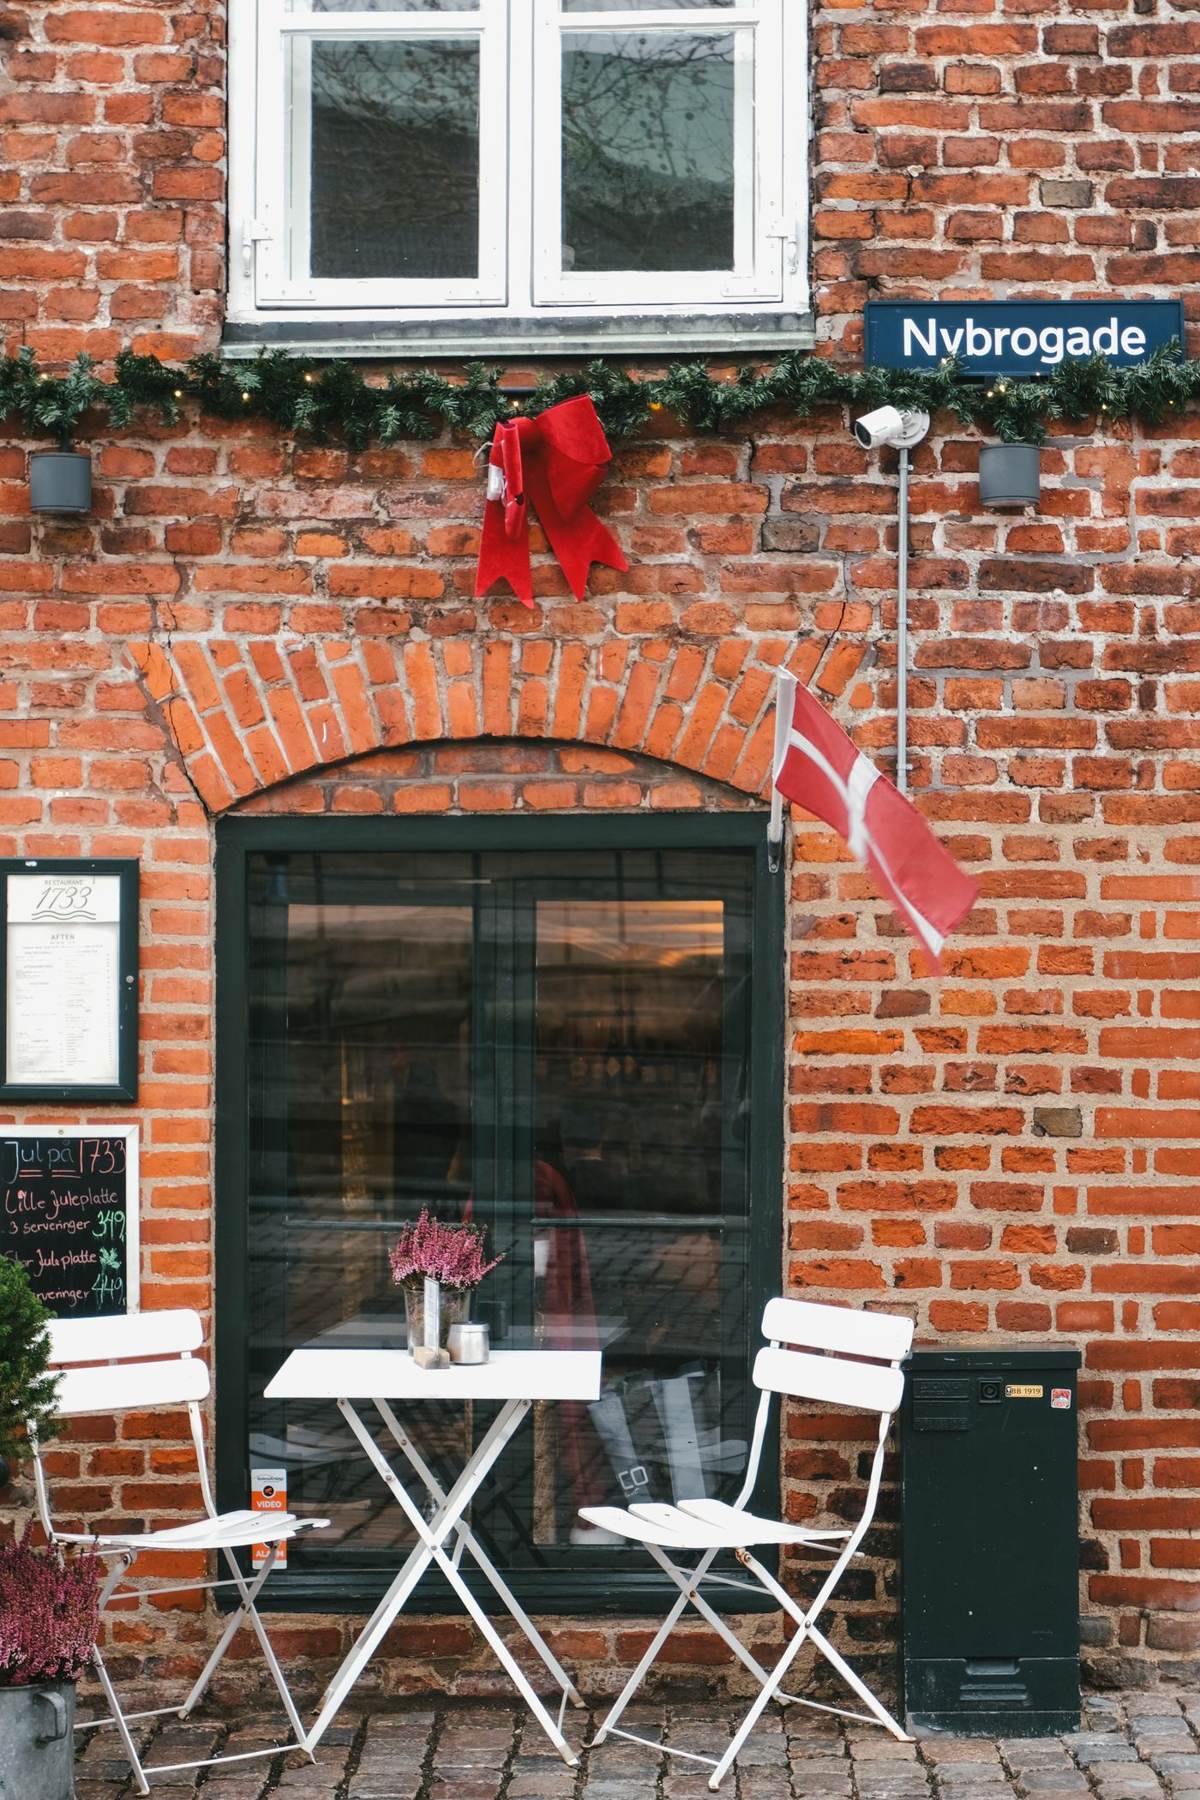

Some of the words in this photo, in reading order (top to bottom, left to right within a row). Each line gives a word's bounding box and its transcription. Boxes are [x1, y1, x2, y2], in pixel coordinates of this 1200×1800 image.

[903, 317, 1146, 363] Nybrogade
[36, 886, 92, 909] 1733
[4, 1140, 43, 1184] Jul
[48, 1139, 74, 1170] på
[79, 1139, 126, 1174] 1733
[5, 1189, 46, 1214] Lille
[9, 1221, 18, 1234] 3
[23, 1219, 90, 1234] serveringer
[256, 1500, 282, 1508] VIDEO
